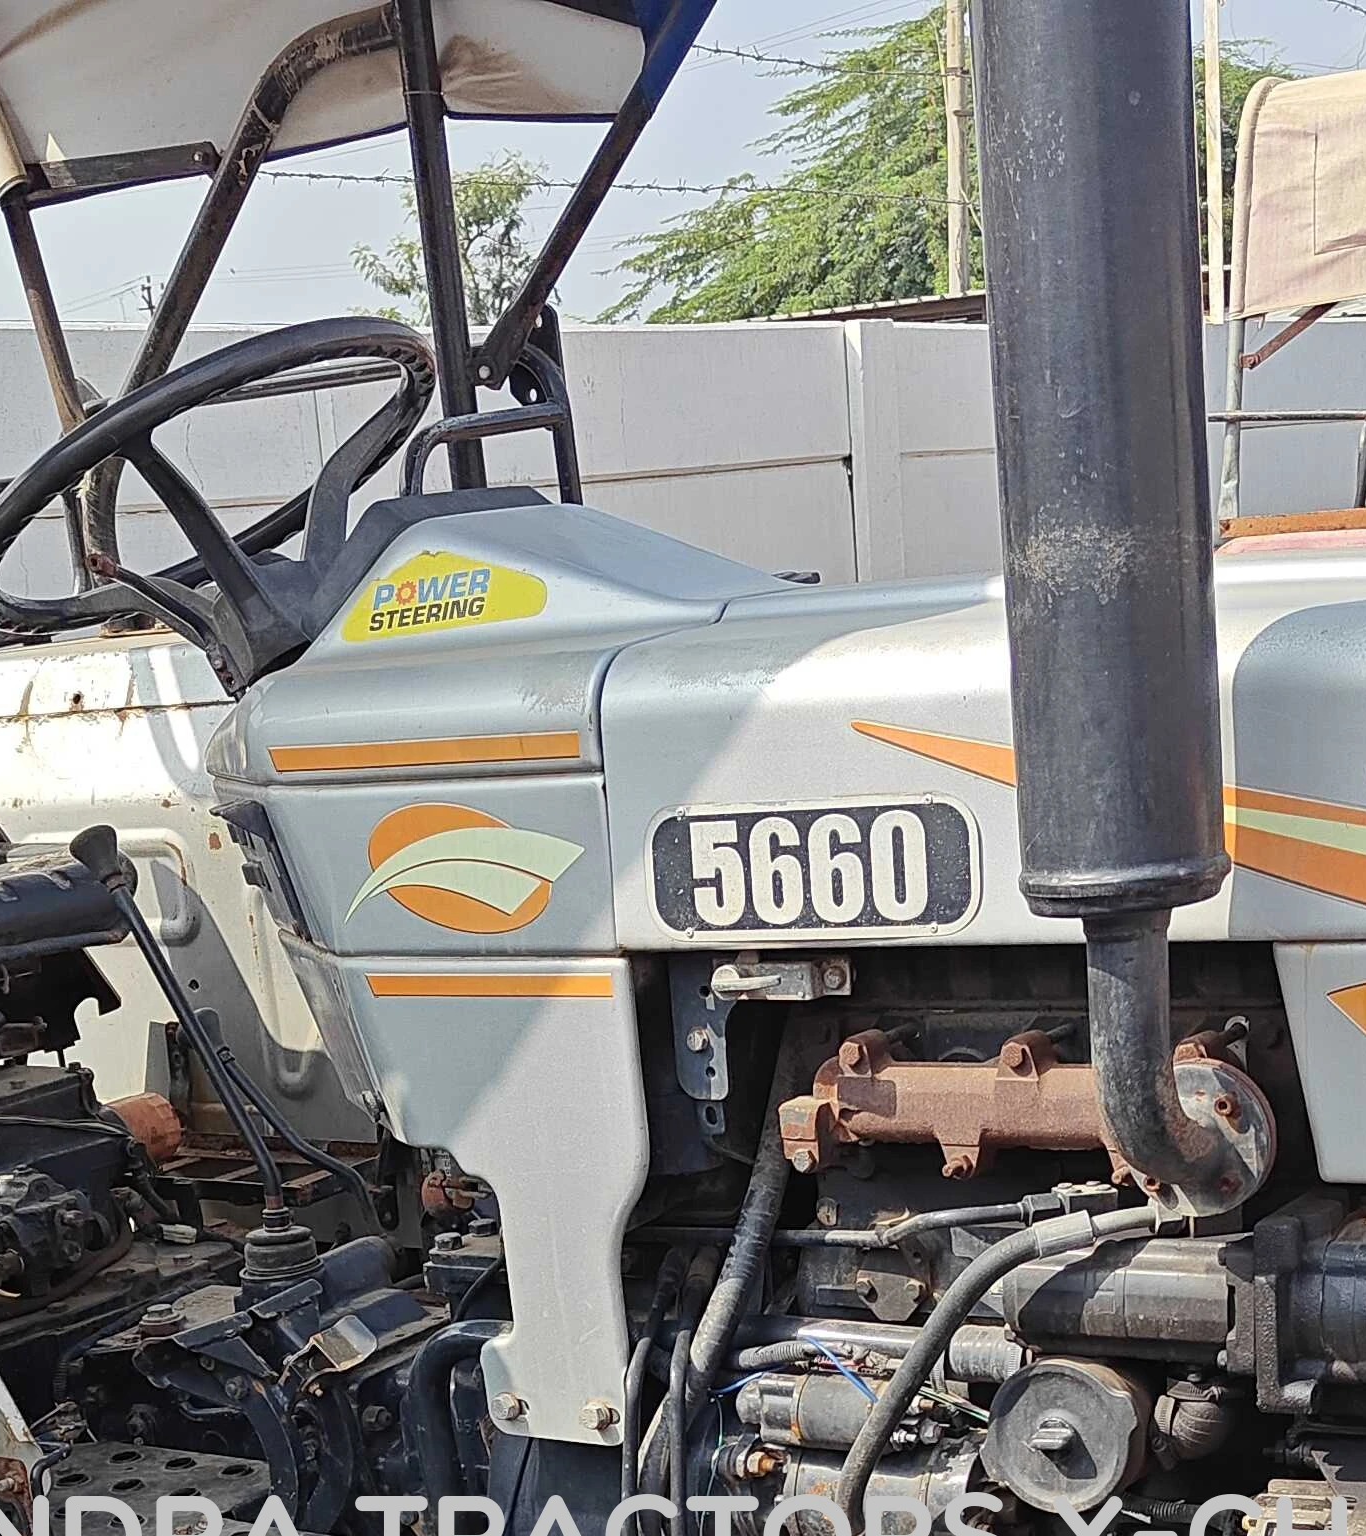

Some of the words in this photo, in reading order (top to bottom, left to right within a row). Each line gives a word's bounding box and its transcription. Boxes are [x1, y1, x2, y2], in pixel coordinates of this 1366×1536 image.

[373, 568, 491, 611] POWER
[368, 596, 486, 632] STEERING
[688, 808, 928, 927] 5660
